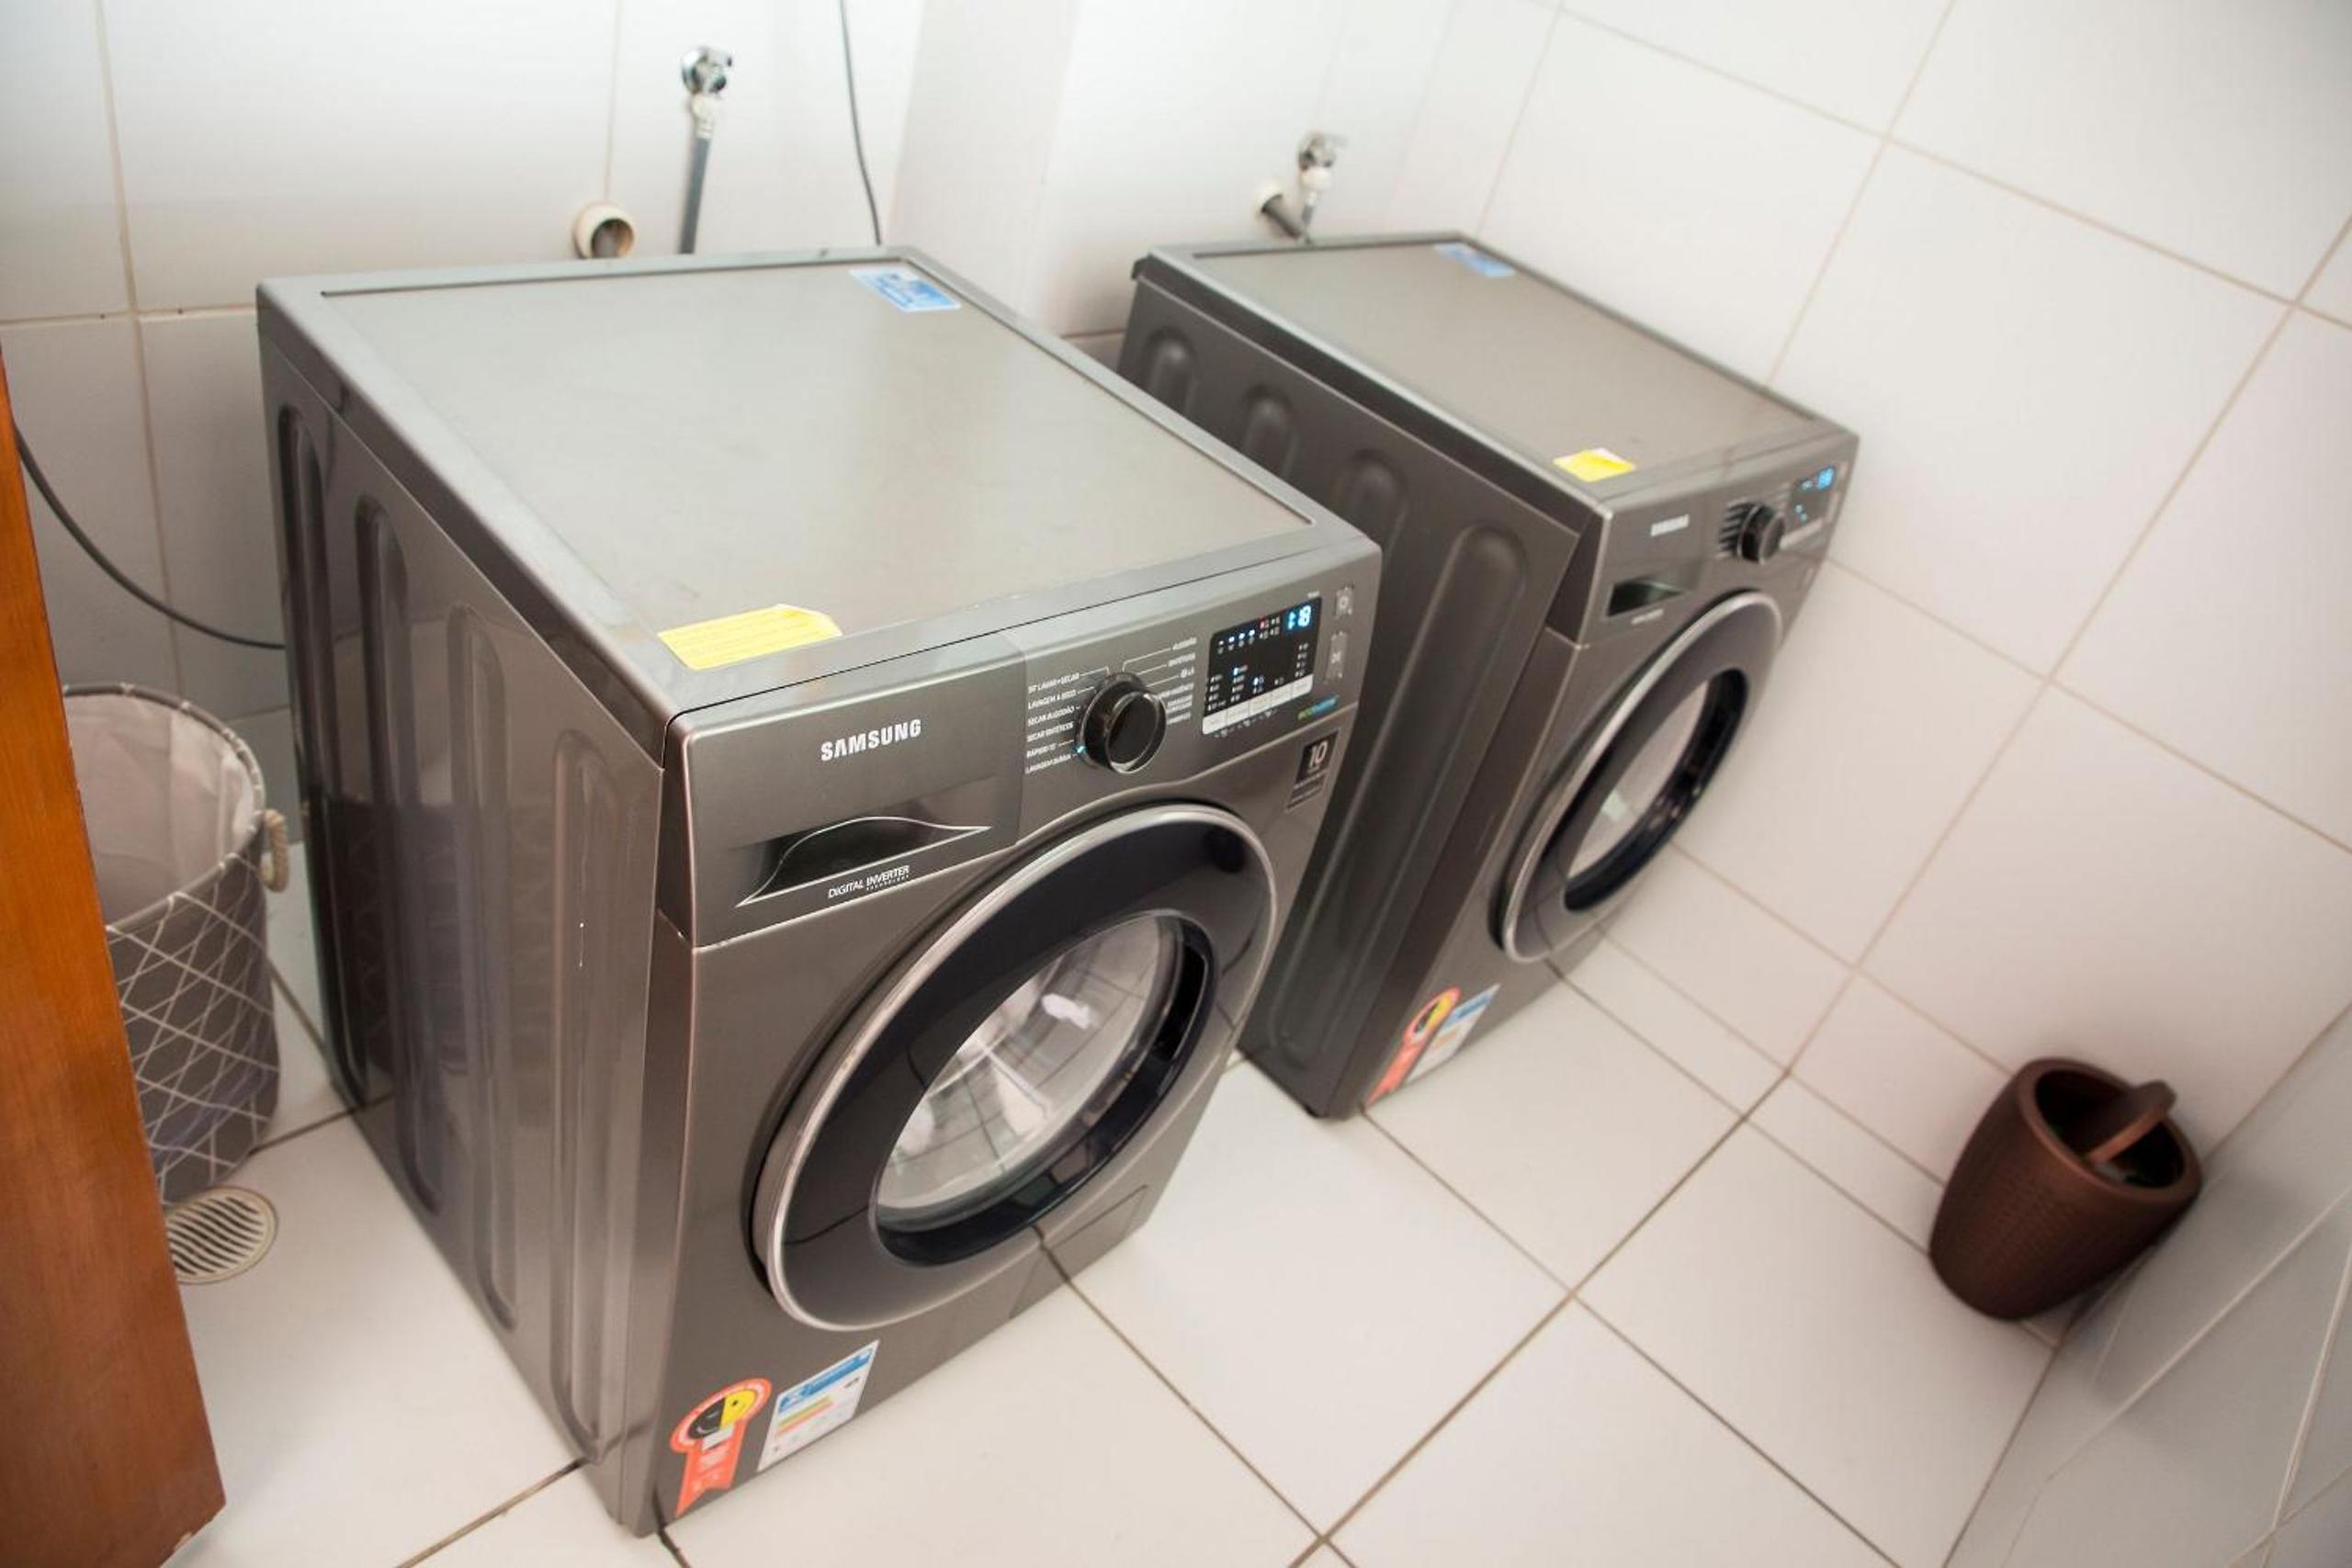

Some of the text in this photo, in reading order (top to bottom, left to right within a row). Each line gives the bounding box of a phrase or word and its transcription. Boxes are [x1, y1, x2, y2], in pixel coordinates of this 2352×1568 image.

[820, 718, 922, 761] SAMSUNG
[828, 865, 910, 899] DIGITAL INVERTER
